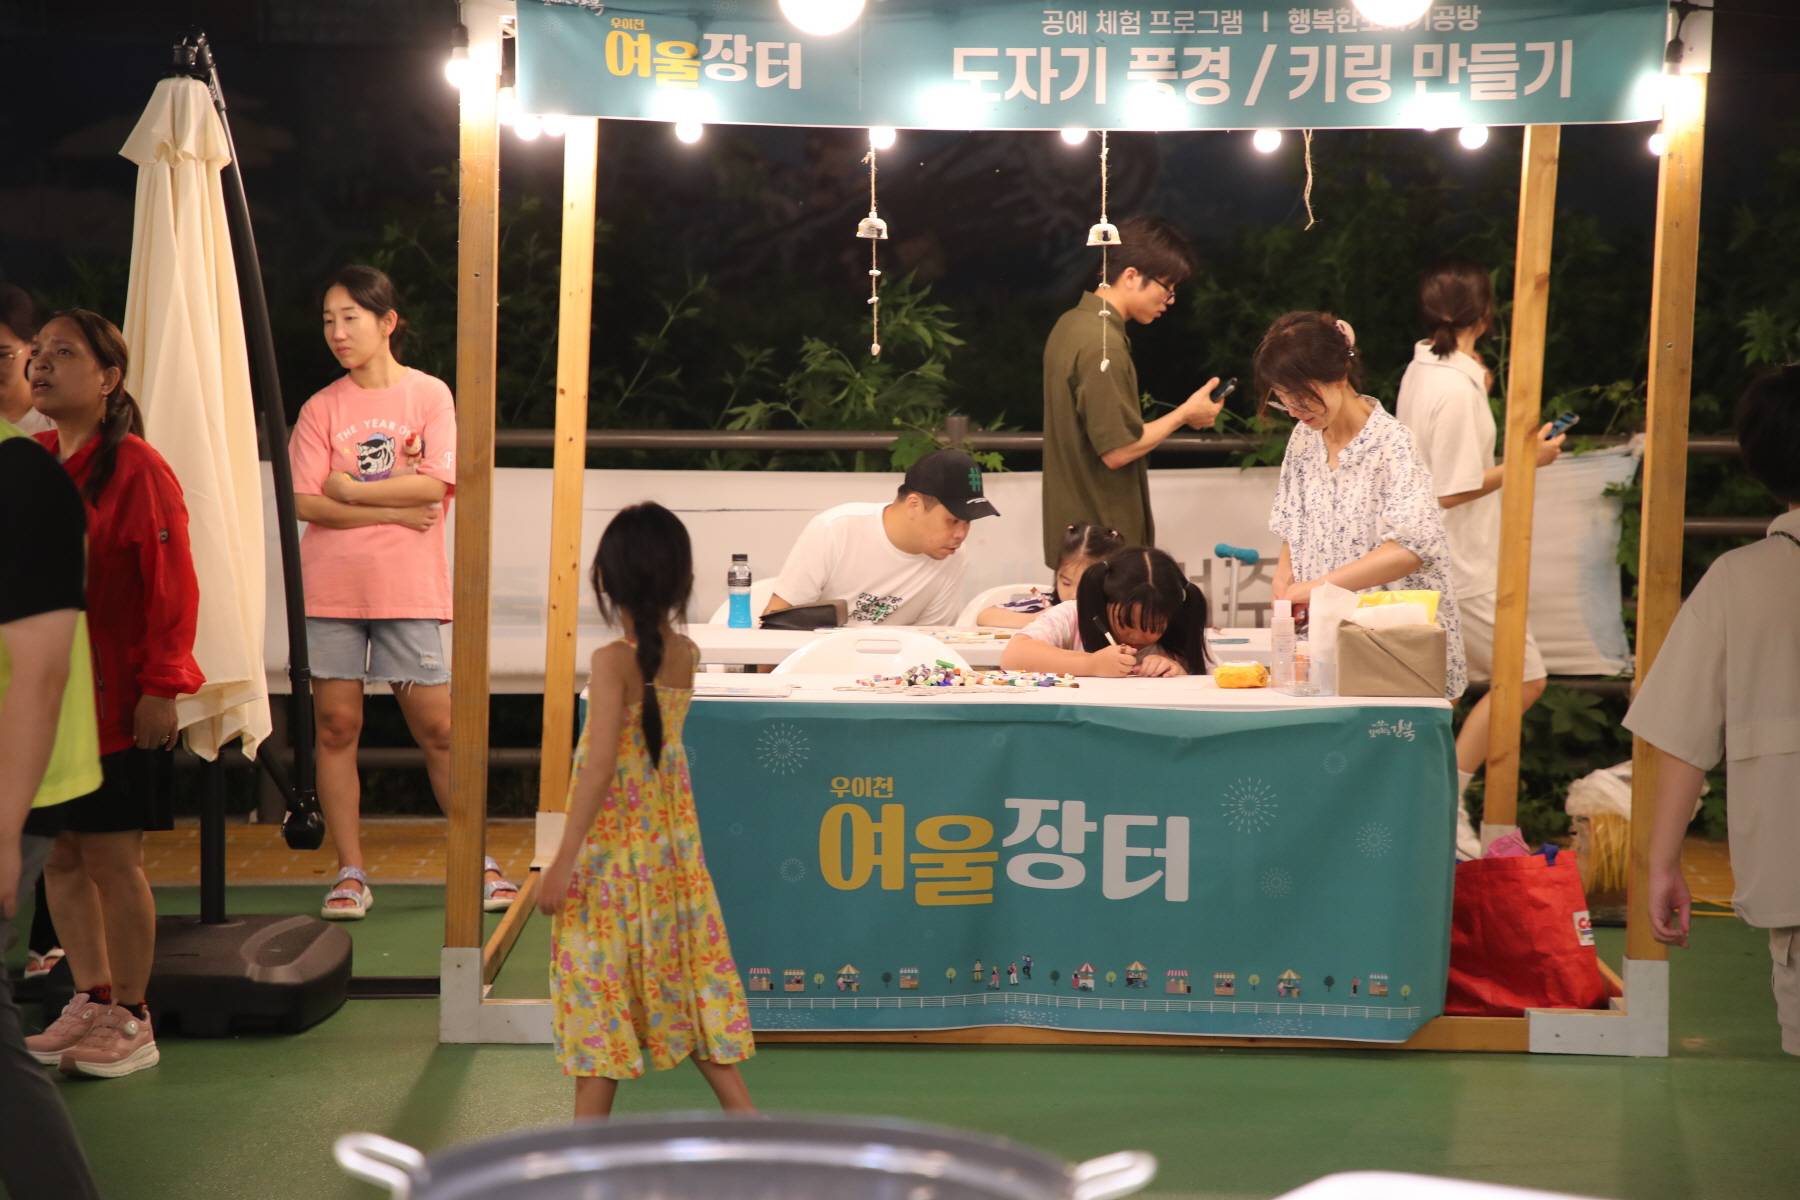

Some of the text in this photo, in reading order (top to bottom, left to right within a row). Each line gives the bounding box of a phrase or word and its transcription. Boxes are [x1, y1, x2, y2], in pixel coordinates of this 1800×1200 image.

[610, 17, 645, 31] 우이천
[1041, 10, 1087, 36] 공예
[1096, 10, 1141, 35] 체험
[1149, 10, 1243, 35] 프로그램
[605, 30, 802, 90] 여울장터
[953, 46, 1107, 105] 도자기
[1127, 46, 1231, 106] 풍경
[1289, 44, 1392, 104] 키링
[1412, 39, 1573, 102] 만들기
[336, 424, 358, 442] THE
[364, 419, 396, 432] YEAR
[1390, 719, 1416, 742] 강북
[829, 776, 894, 798] 우이천
[818, 798, 1191, 906] 여울장터
